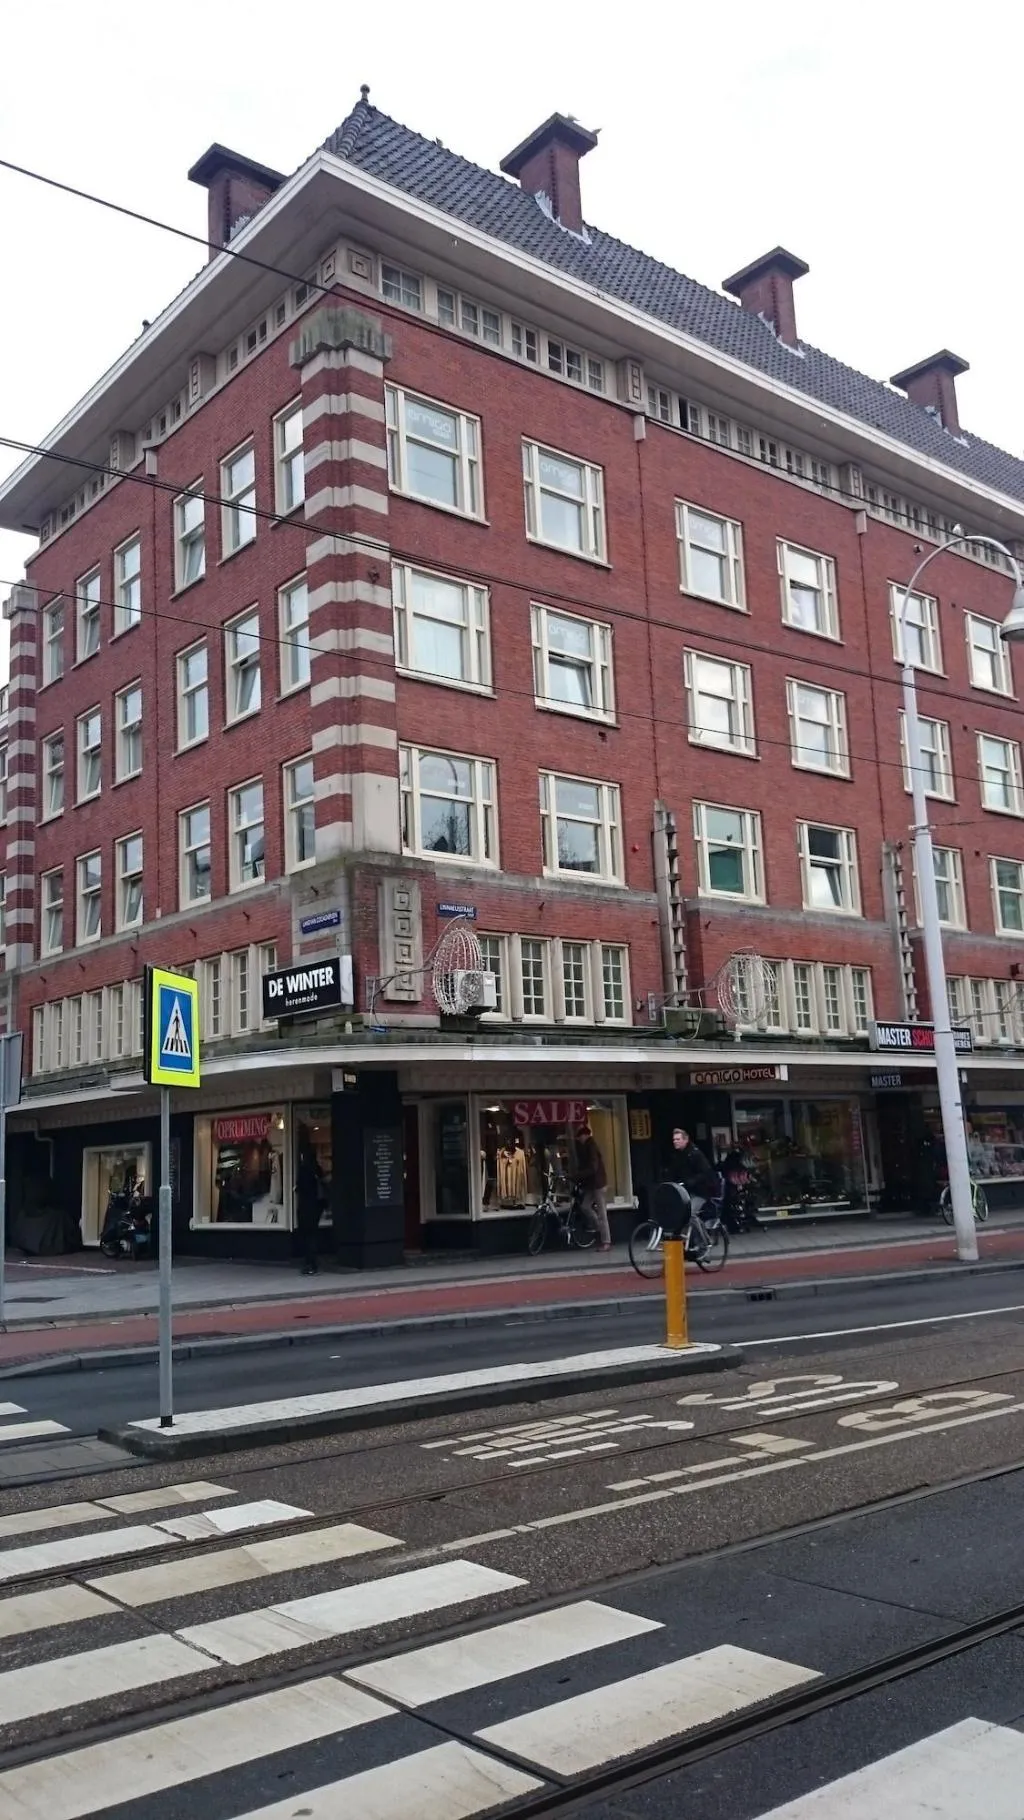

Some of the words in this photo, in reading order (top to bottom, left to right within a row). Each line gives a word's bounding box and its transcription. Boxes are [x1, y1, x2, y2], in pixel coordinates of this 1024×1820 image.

[268, 978, 284, 998] DE
[286, 966, 334, 993] WINTER
[285, 992, 318, 1006] herenmode
[877, 1027, 912, 1046] MASTER
[743, 1067, 775, 1080] HOTEL
[871, 1075, 902, 1087] MASTER
[514, 1101, 586, 1124] SALE
